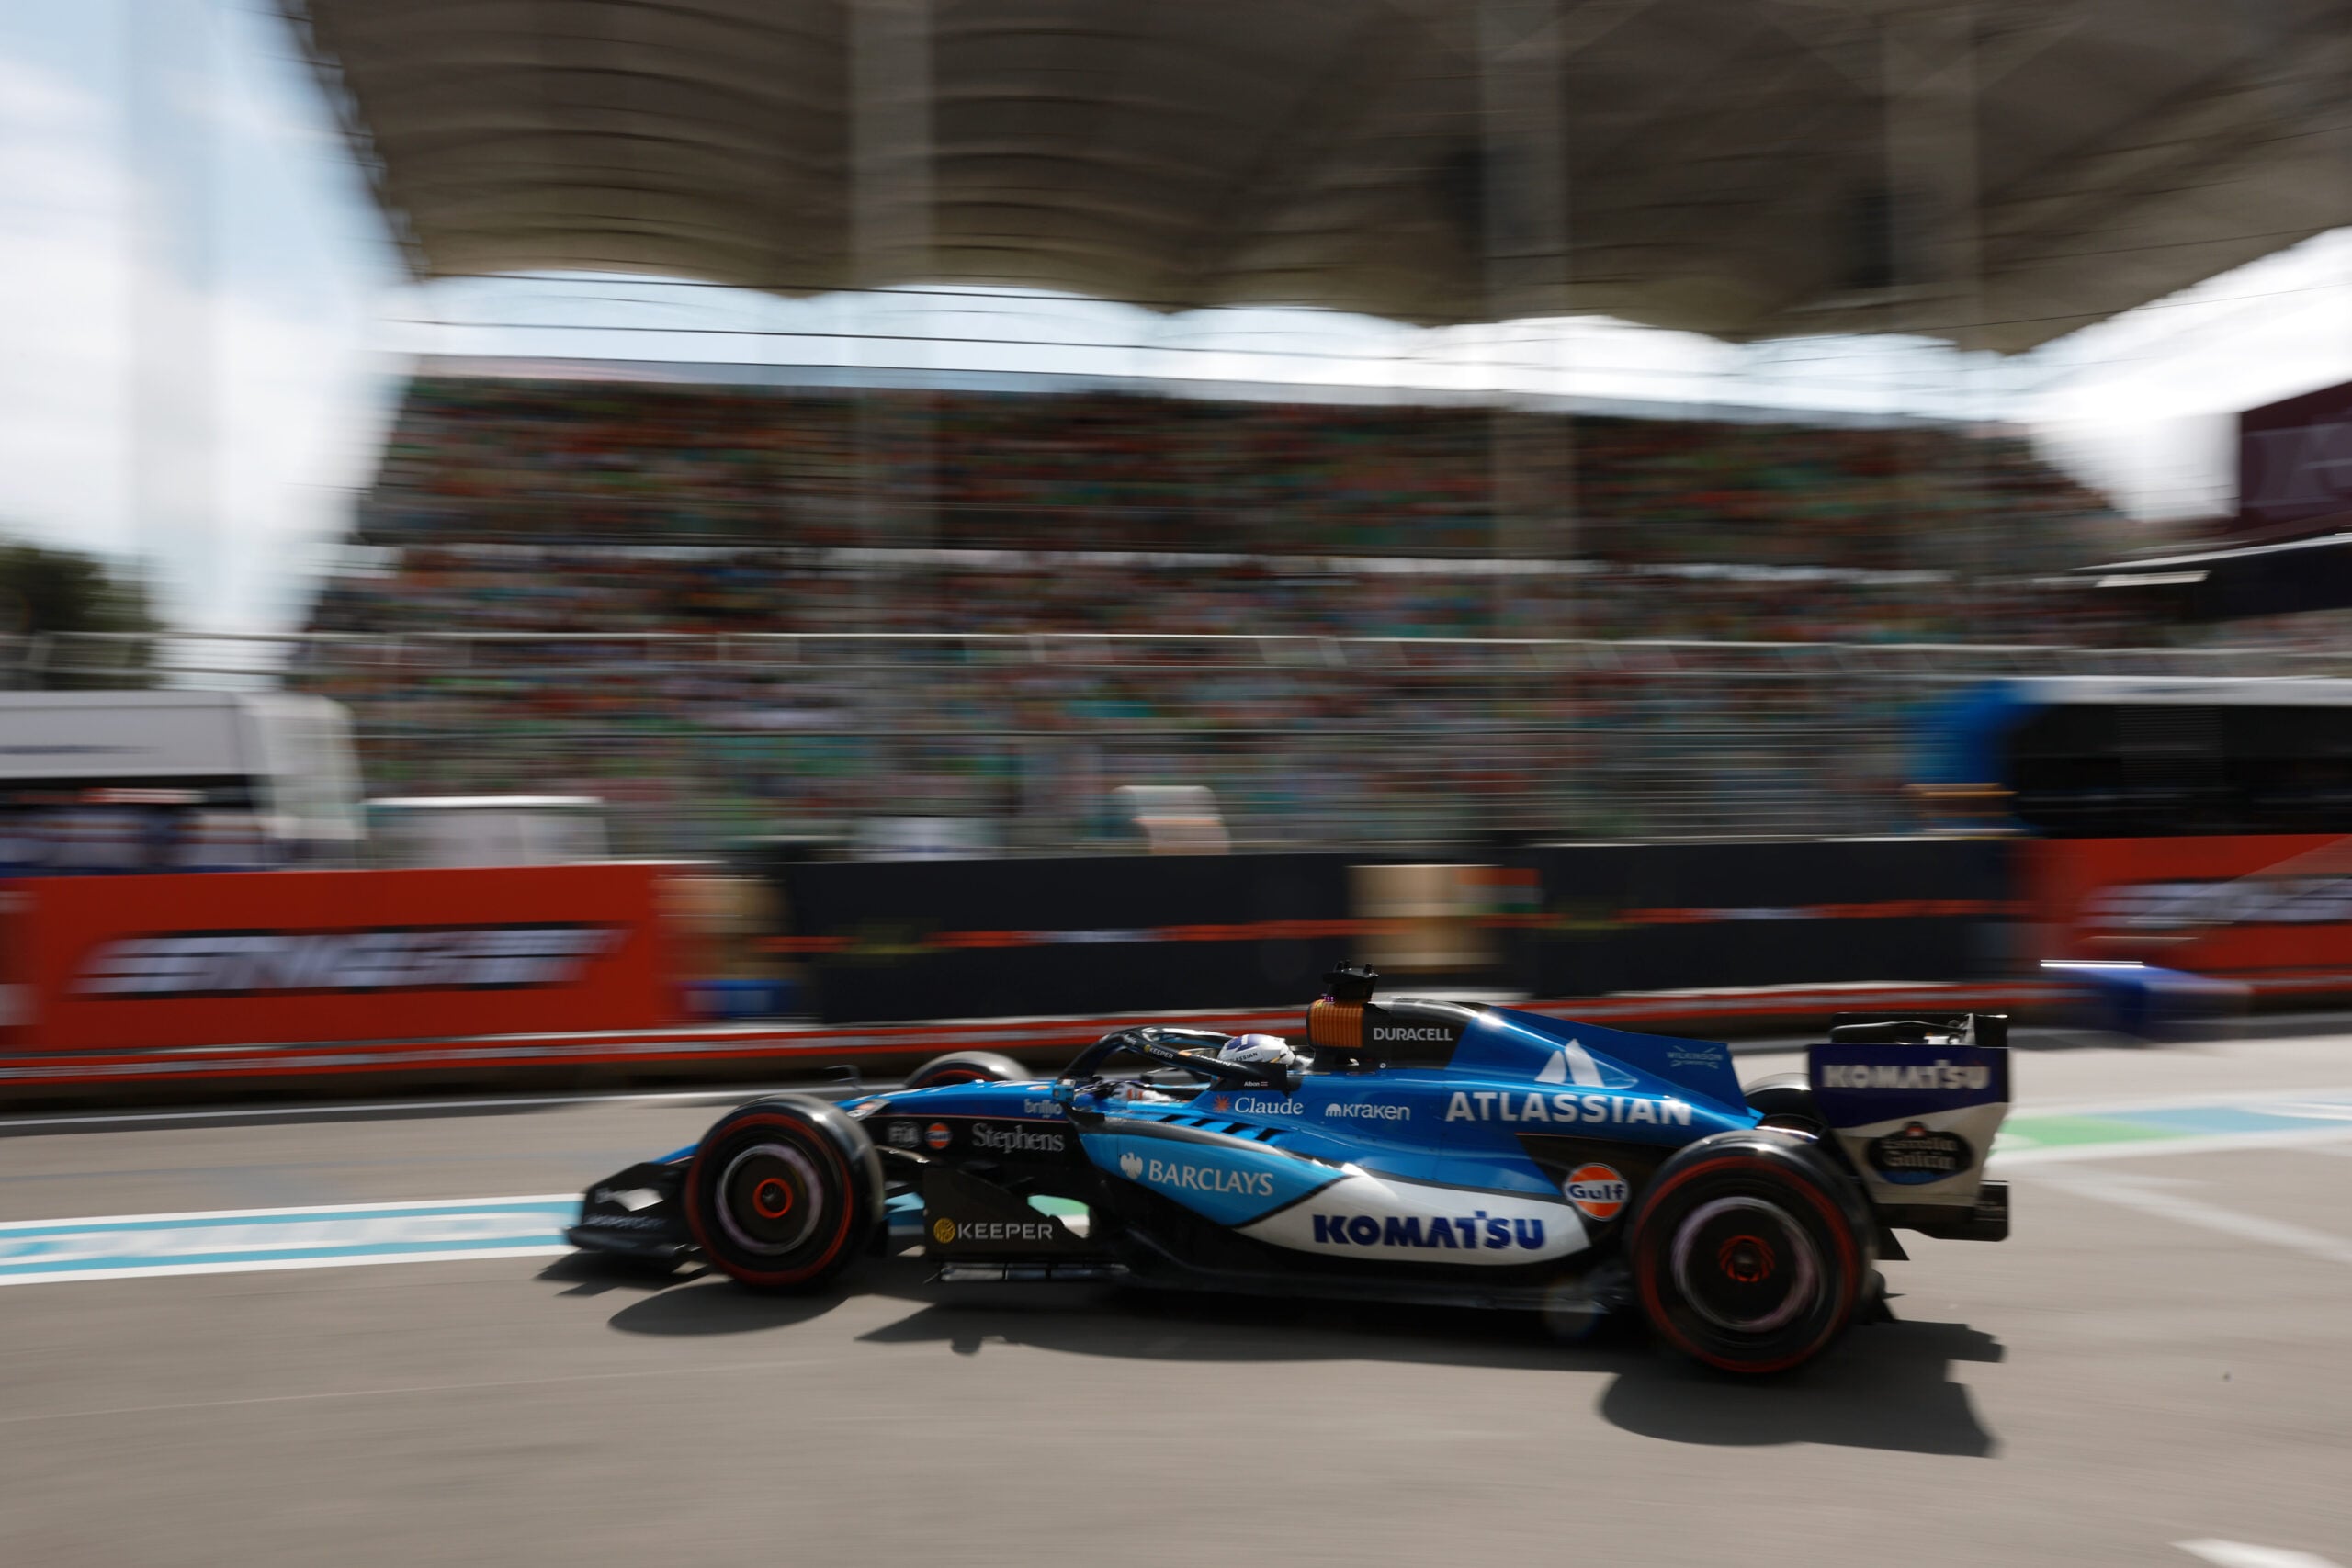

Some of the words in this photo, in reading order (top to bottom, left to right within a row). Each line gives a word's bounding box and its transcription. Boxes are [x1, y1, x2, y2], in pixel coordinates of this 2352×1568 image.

[1373, 1027, 1453, 1042] DURACELL
[1822, 1059, 1991, 1089] KOMATSU
[1234, 1097, 1304, 1115] Claude
[1445, 1092, 1692, 1126] ATLASSIAN
[972, 1122, 1065, 1154] Stephens
[1148, 1162, 1273, 1196] BARCLAYS
[1568, 1183, 1626, 1201] Gulf
[957, 1223, 1053, 1240] KEEPER
[1313, 1210, 1544, 1250] KOMATSU
